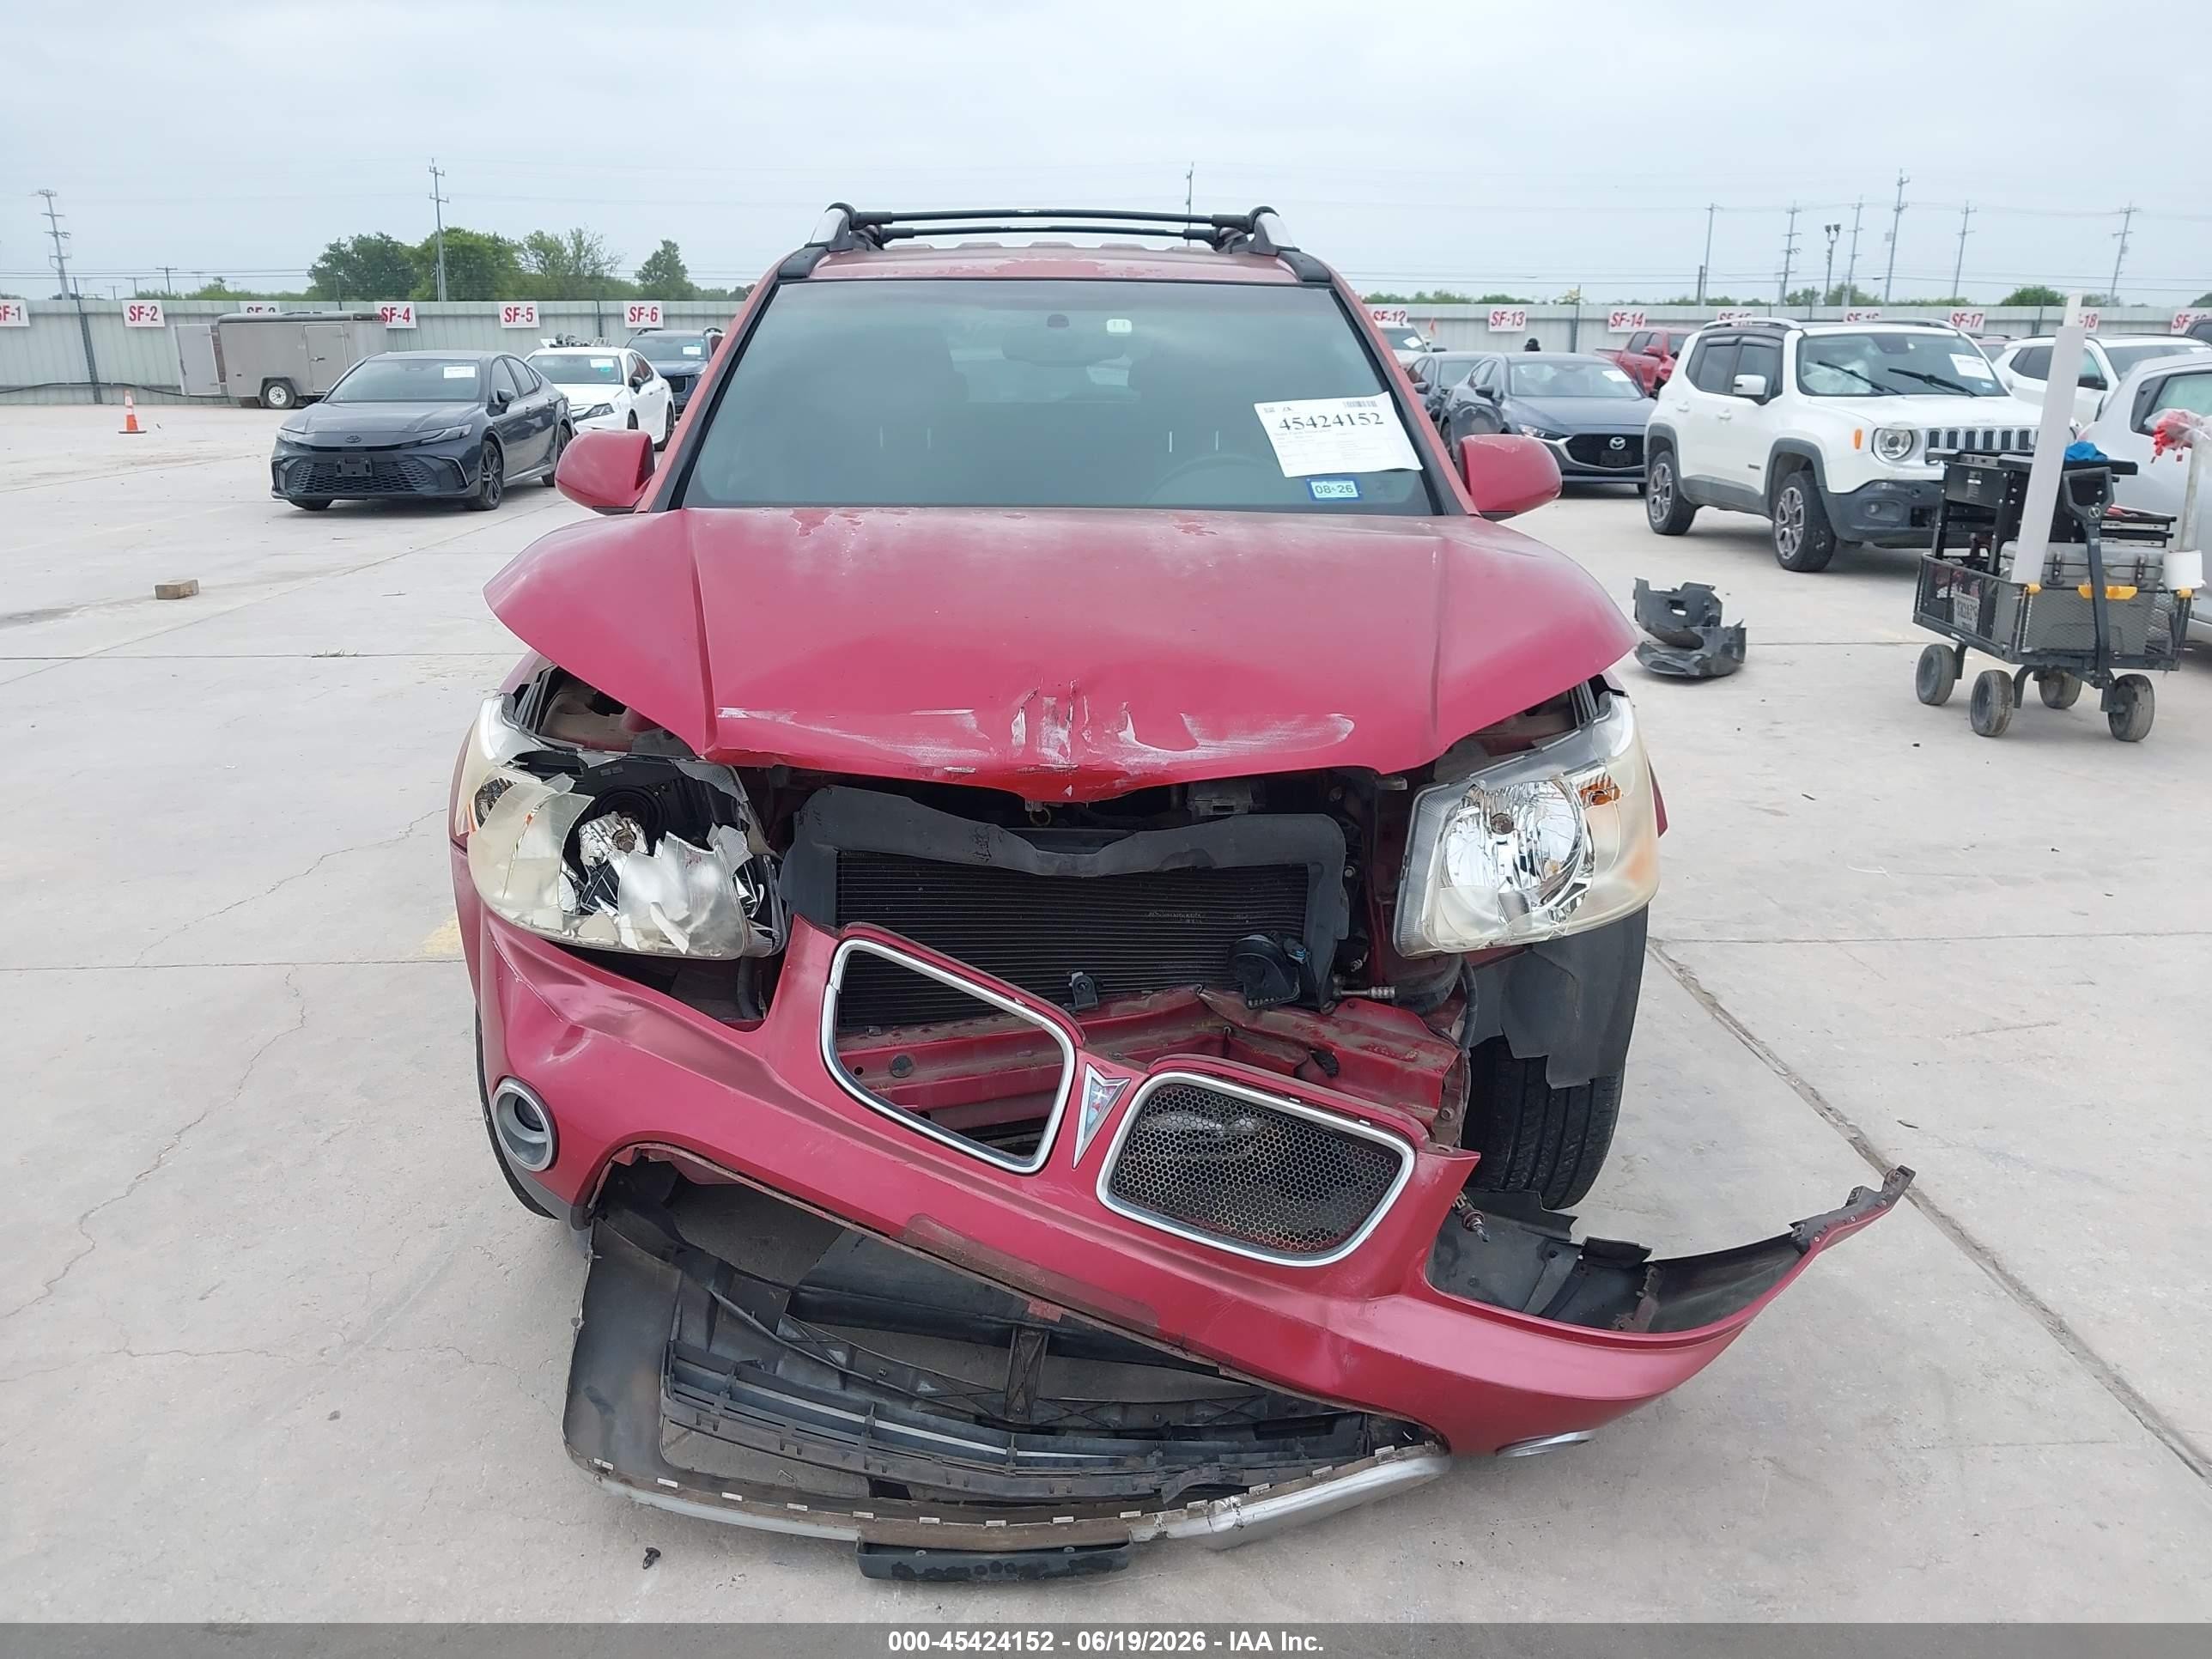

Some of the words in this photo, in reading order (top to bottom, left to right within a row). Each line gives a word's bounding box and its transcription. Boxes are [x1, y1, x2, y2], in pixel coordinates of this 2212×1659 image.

[129, 306, 158, 321] SF-2
[380, 307, 411, 323] SF-4
[504, 307, 534, 322] SF-5
[629, 307, 659, 322] SF-6
[1491, 311, 1525, 326] SF-13
[1611, 312, 1644, 327] SF-14
[1952, 313, 1984, 328] SF-17
[1279, 412, 1384, 430] 45424152
